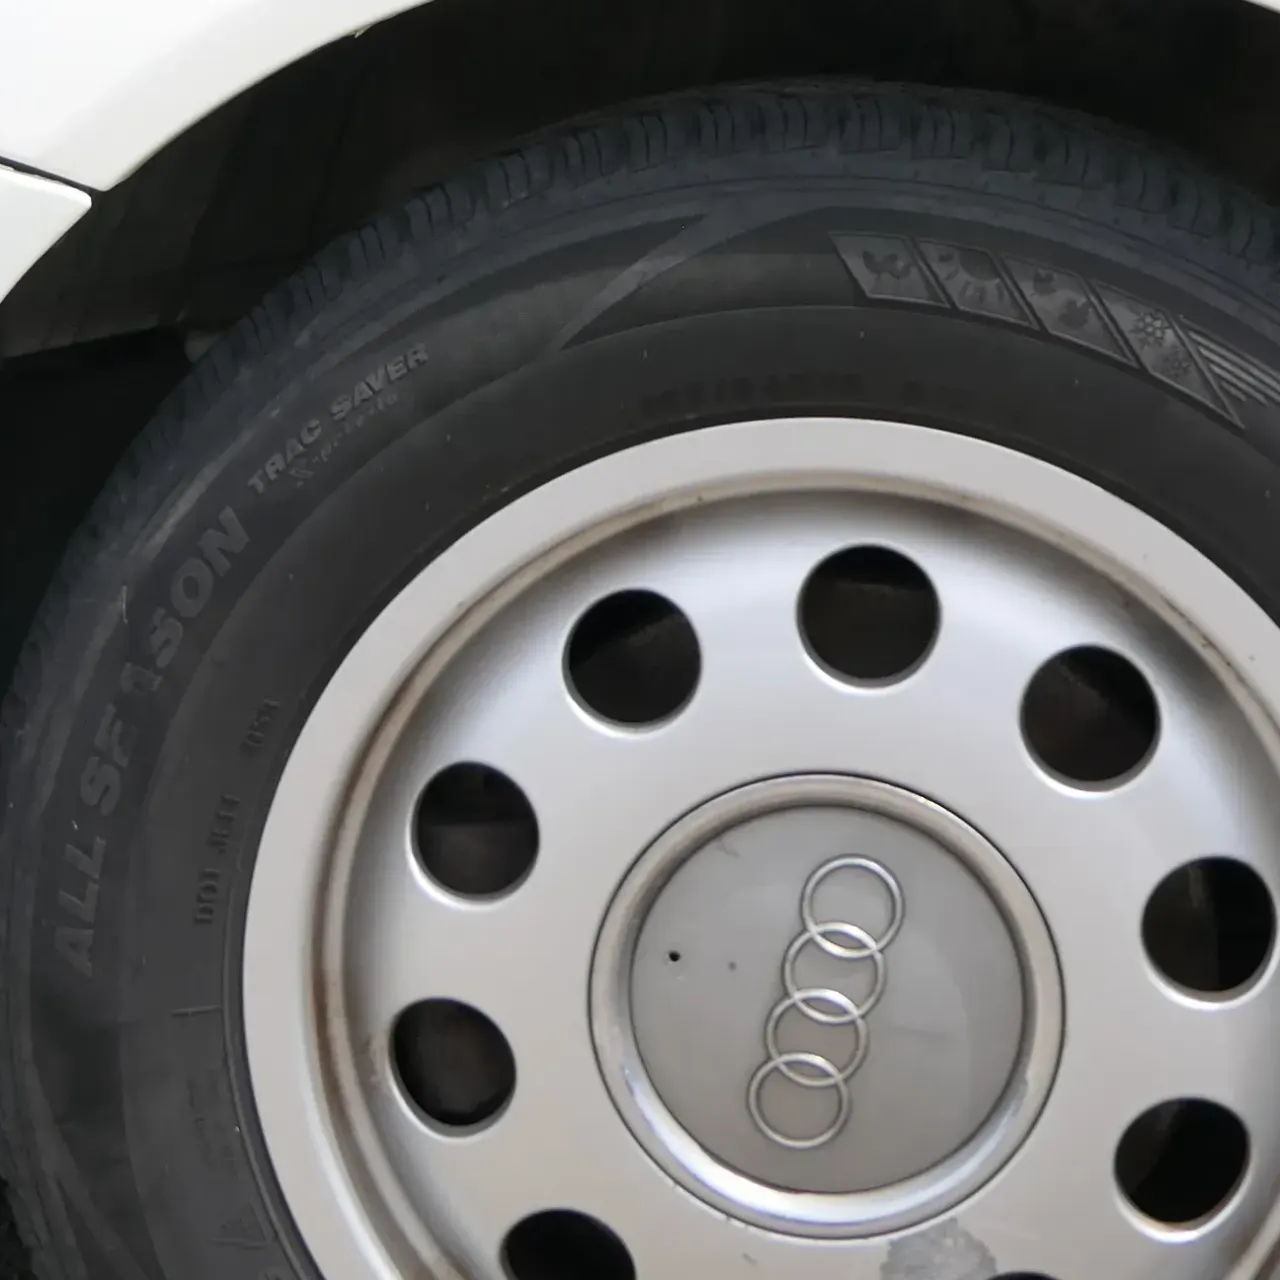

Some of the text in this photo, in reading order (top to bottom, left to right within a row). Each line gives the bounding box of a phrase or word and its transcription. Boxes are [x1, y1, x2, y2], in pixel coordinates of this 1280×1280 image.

[247, 419, 321, 494] TRAC
[329, 342, 429, 421] SAVER
[54, 835, 107, 978] ALL
